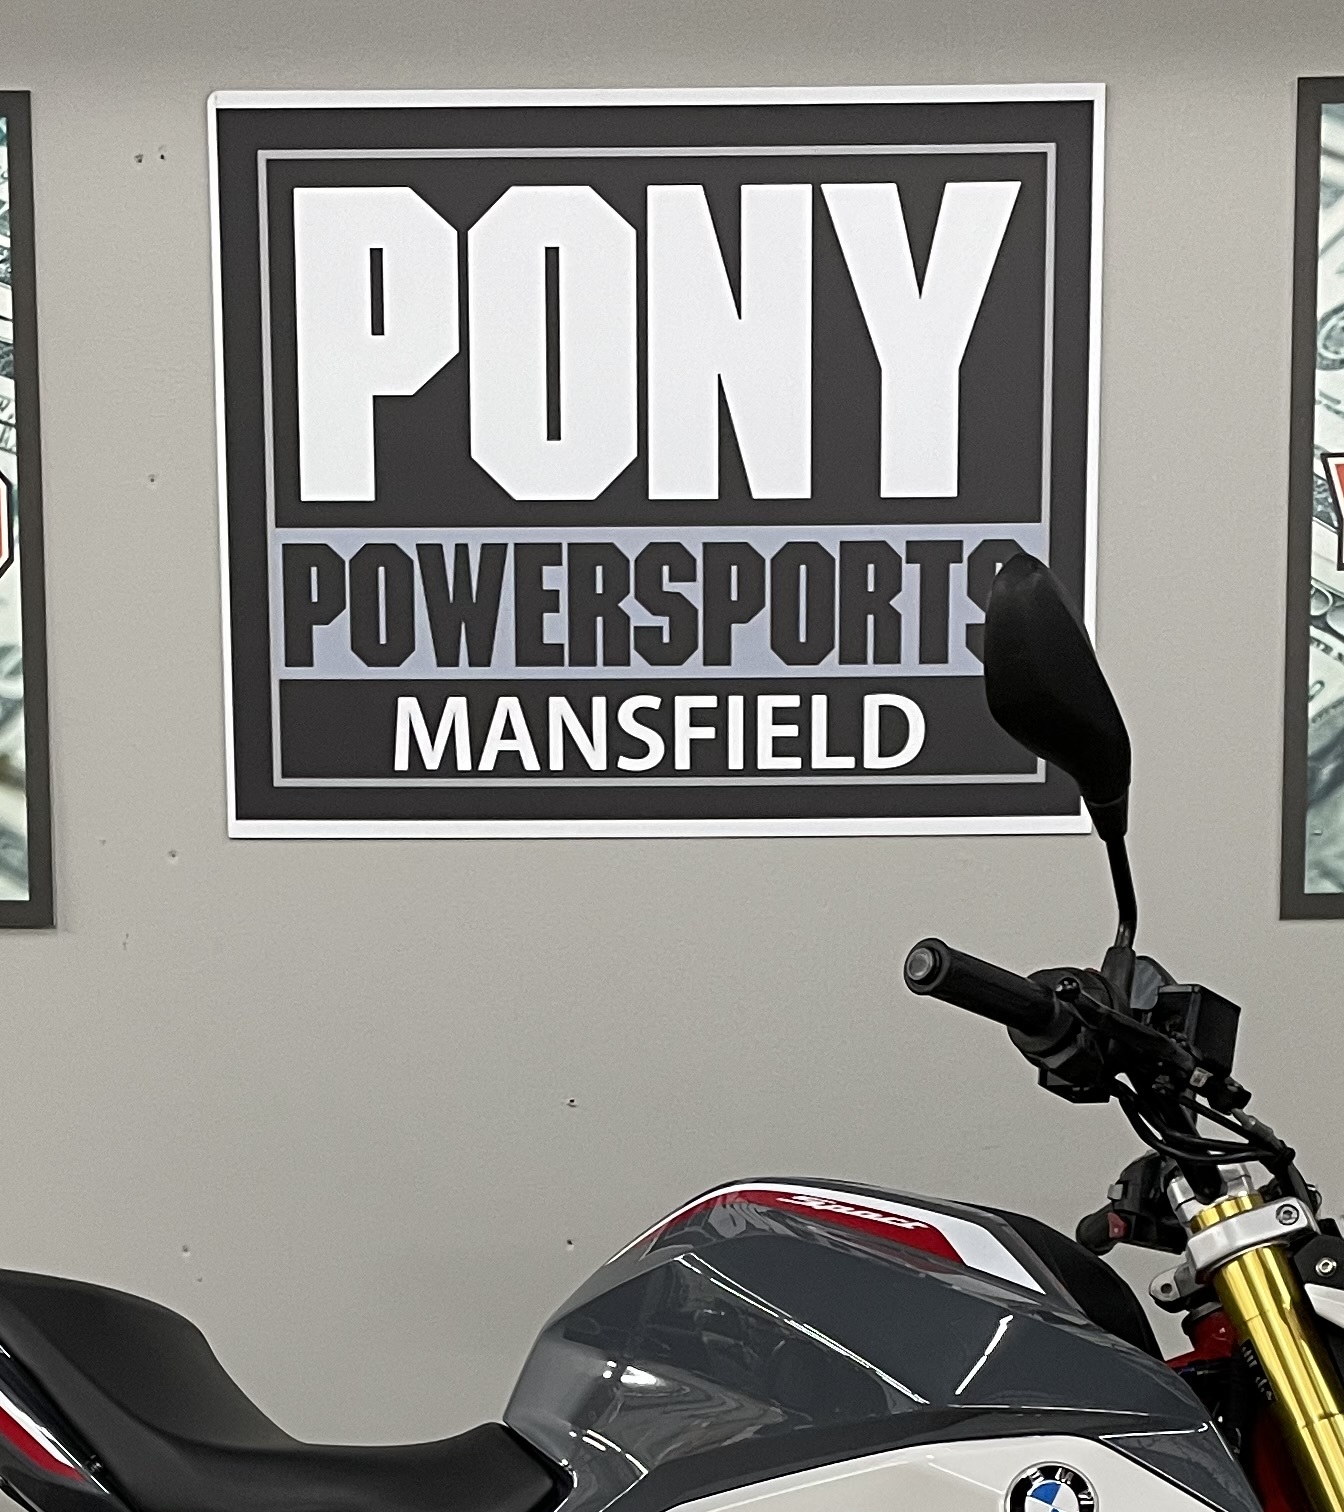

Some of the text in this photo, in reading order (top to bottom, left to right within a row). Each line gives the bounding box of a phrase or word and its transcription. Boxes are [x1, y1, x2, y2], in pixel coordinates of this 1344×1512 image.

[294, 181, 1022, 502] PONY
[394, 693, 926, 771] MANSFIELD
[1024, 1467, 1094, 1505] BMW
